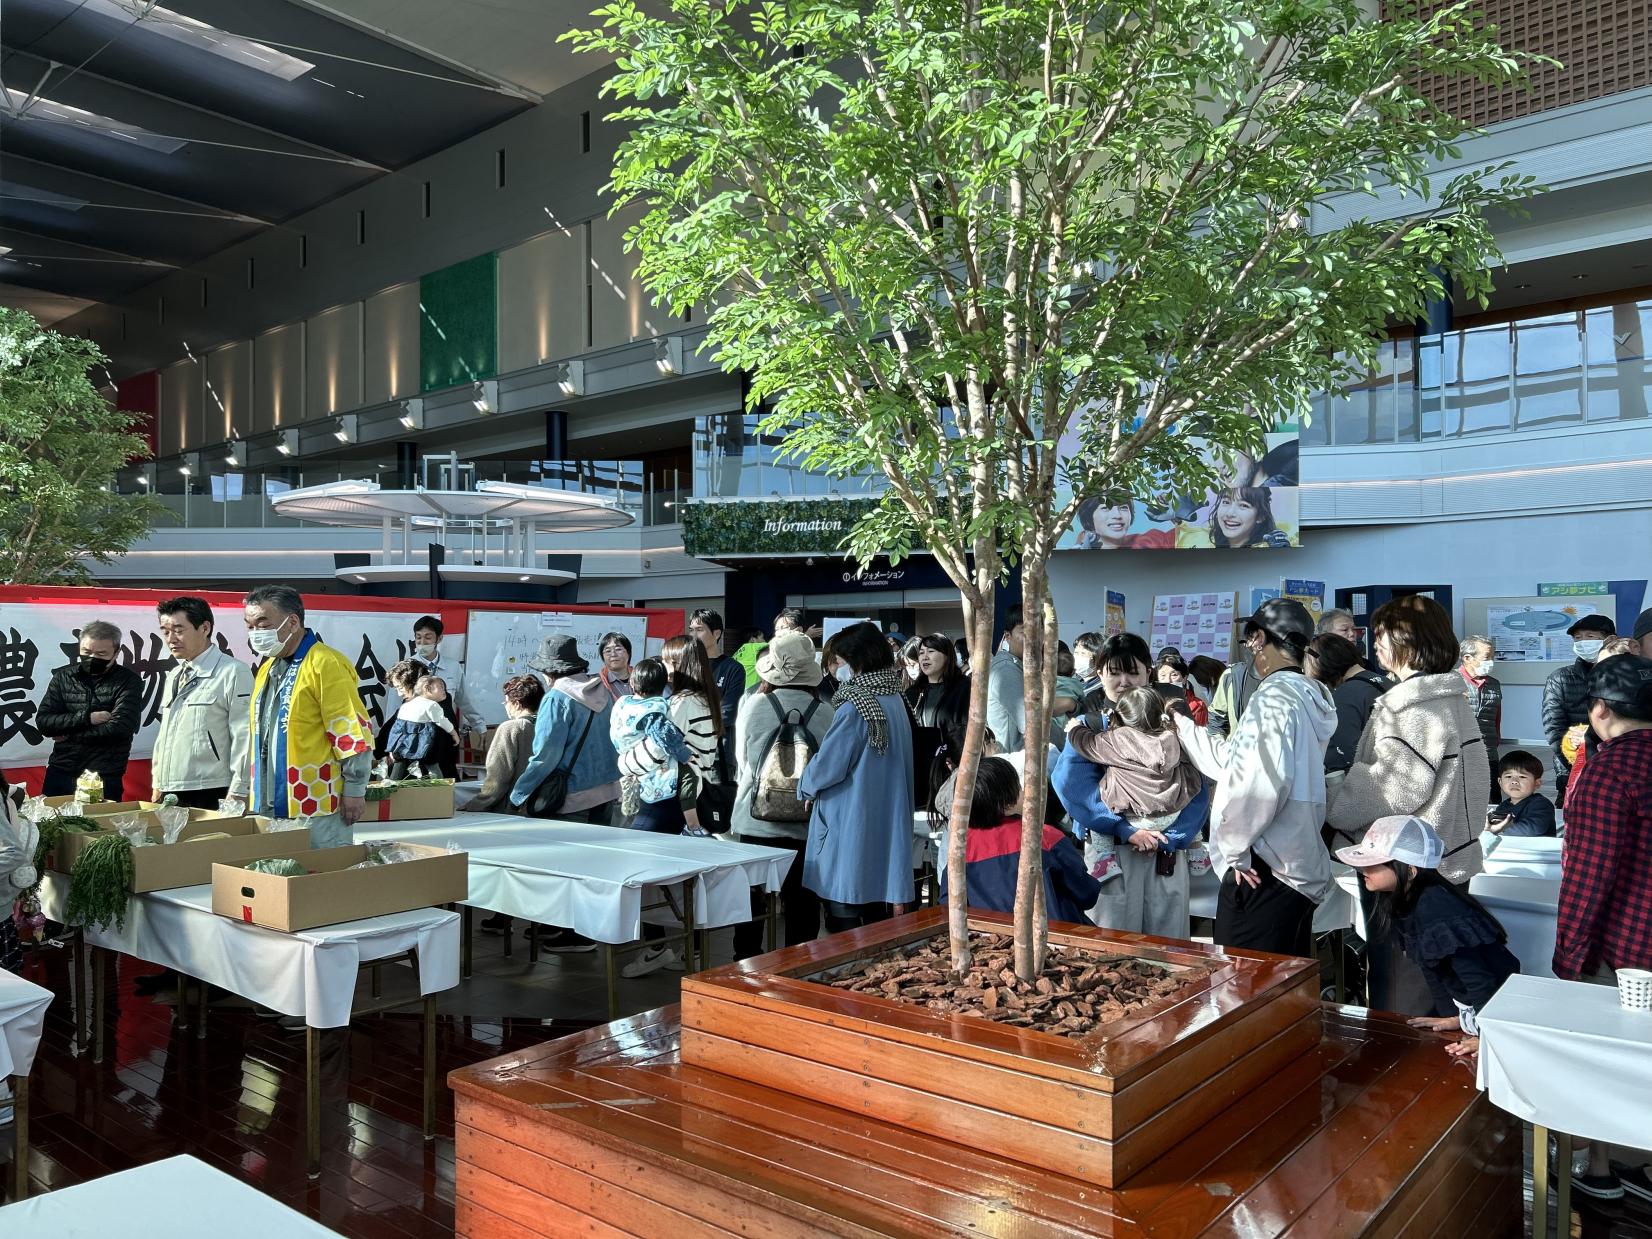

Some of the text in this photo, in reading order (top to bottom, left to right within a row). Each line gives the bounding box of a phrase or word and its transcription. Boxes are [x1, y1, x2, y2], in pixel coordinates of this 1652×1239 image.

[761, 516, 842, 536] Information
[851, 571, 905, 582] イフォメーション
